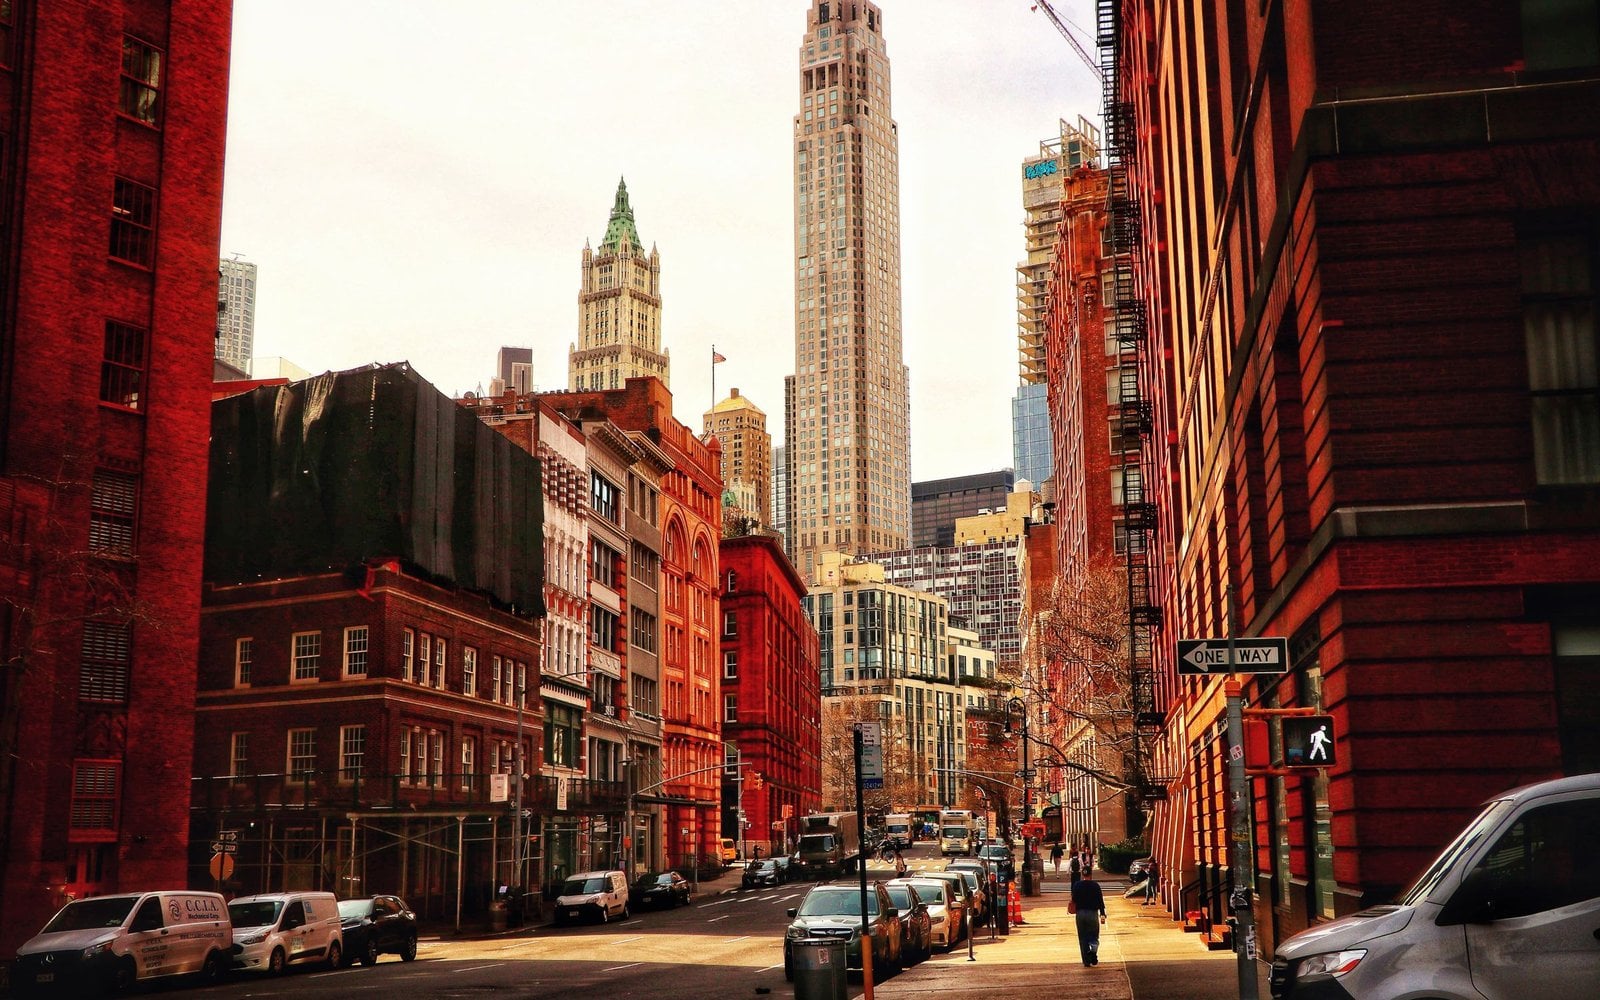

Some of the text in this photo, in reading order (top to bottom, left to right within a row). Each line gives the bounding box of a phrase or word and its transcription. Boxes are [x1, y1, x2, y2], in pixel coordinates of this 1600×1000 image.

[1194, 649, 1271, 664] ONE WAY
[185, 900, 219, 912] C.C.I.A.
